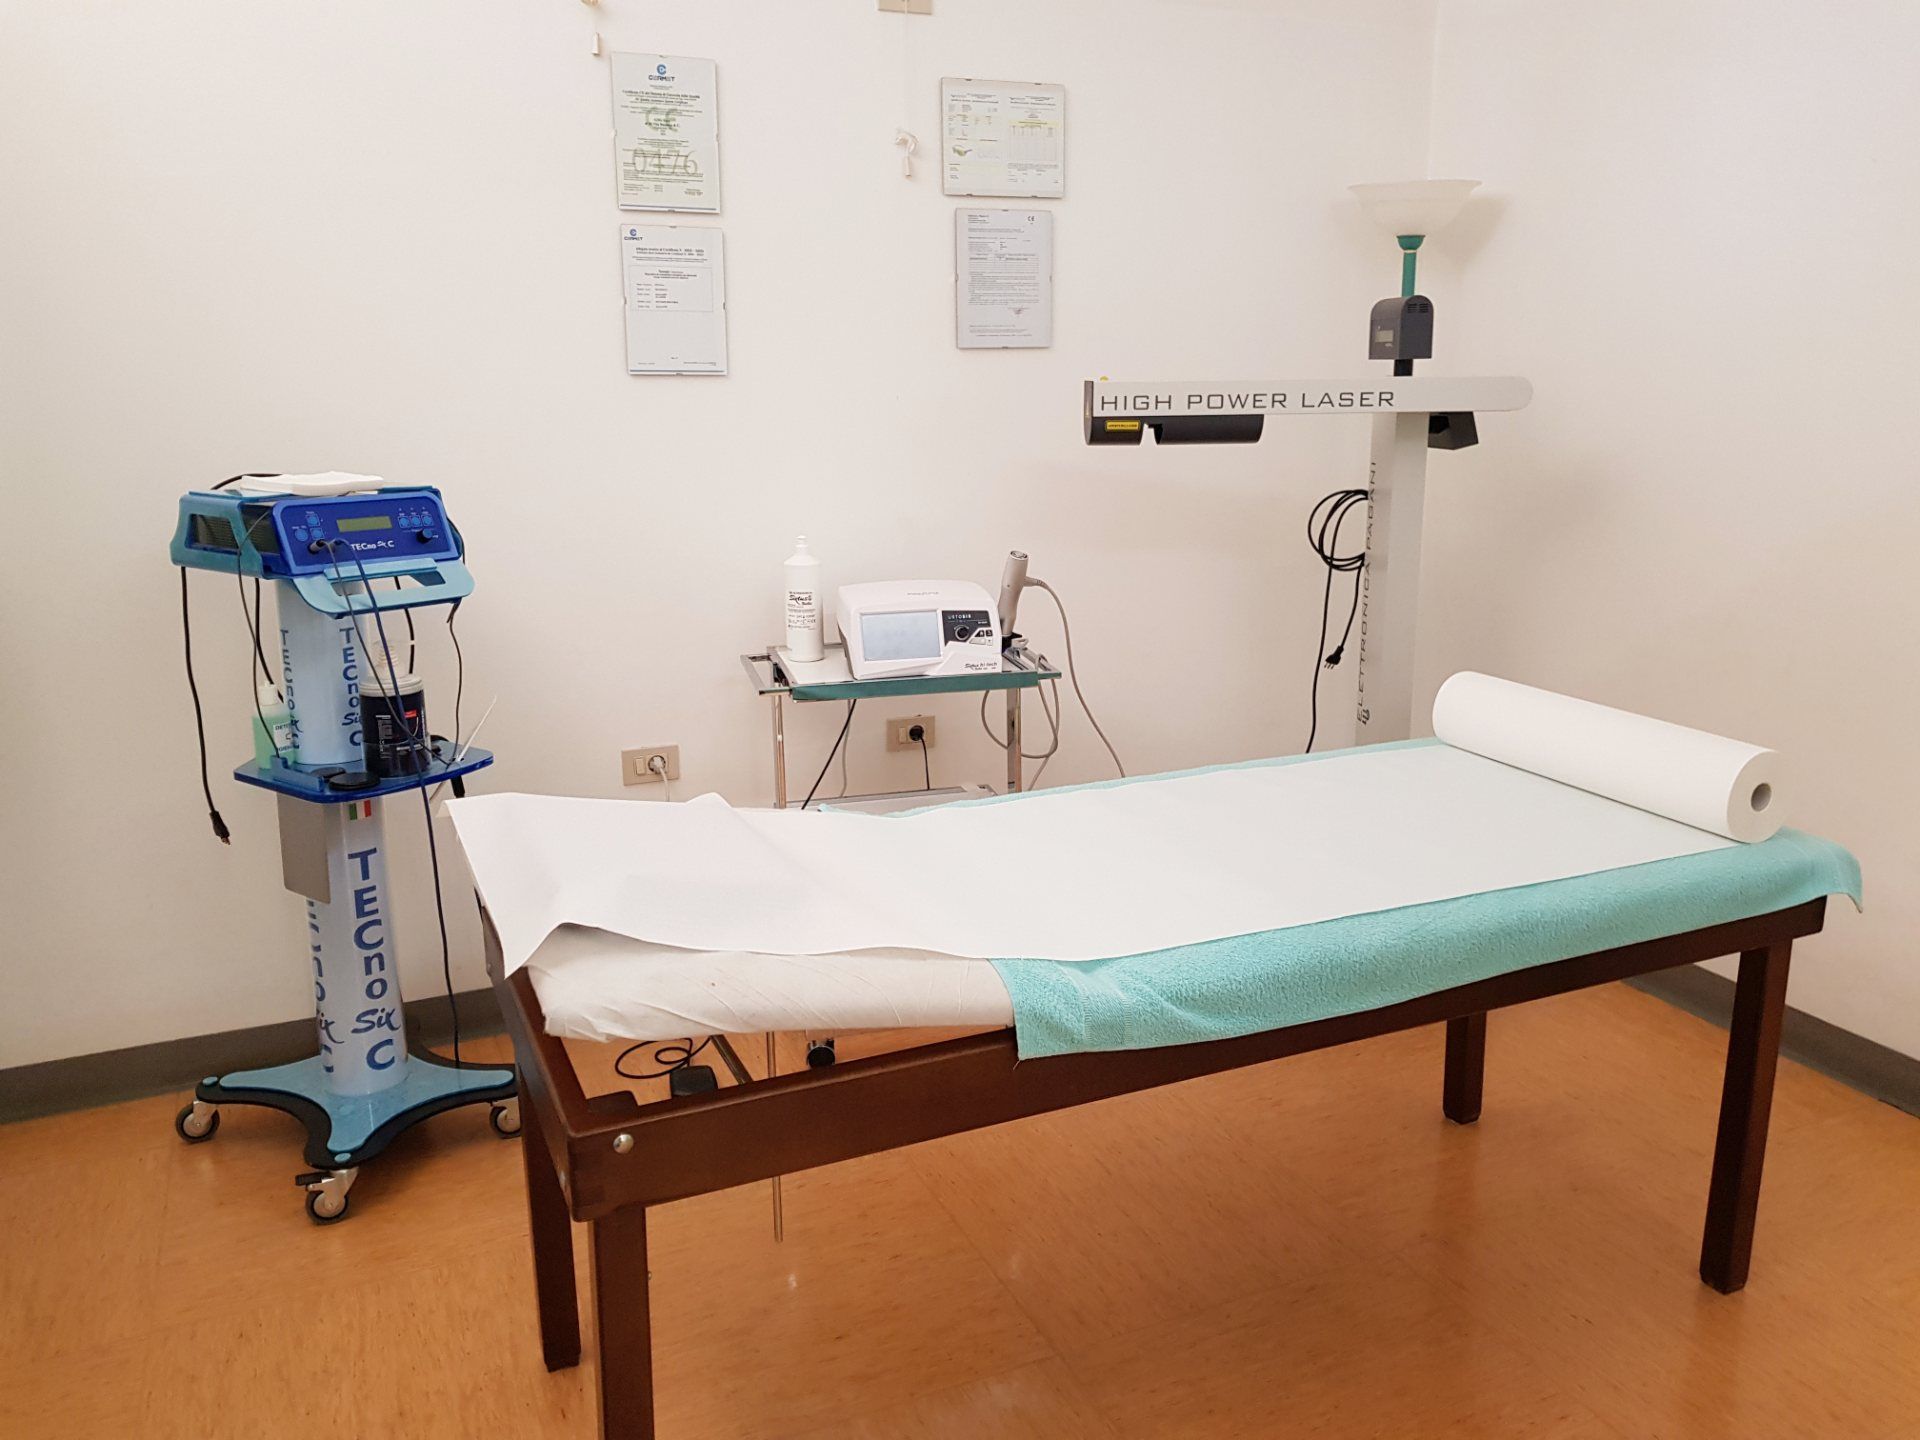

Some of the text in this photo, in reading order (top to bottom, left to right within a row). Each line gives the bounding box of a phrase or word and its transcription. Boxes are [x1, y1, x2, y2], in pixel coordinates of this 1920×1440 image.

[1101, 391, 1395, 411] HIGH POWER LASER
[339, 627, 360, 708] TECno
[341, 711, 361, 727] Si
[347, 847, 401, 1070] TECno Six C
